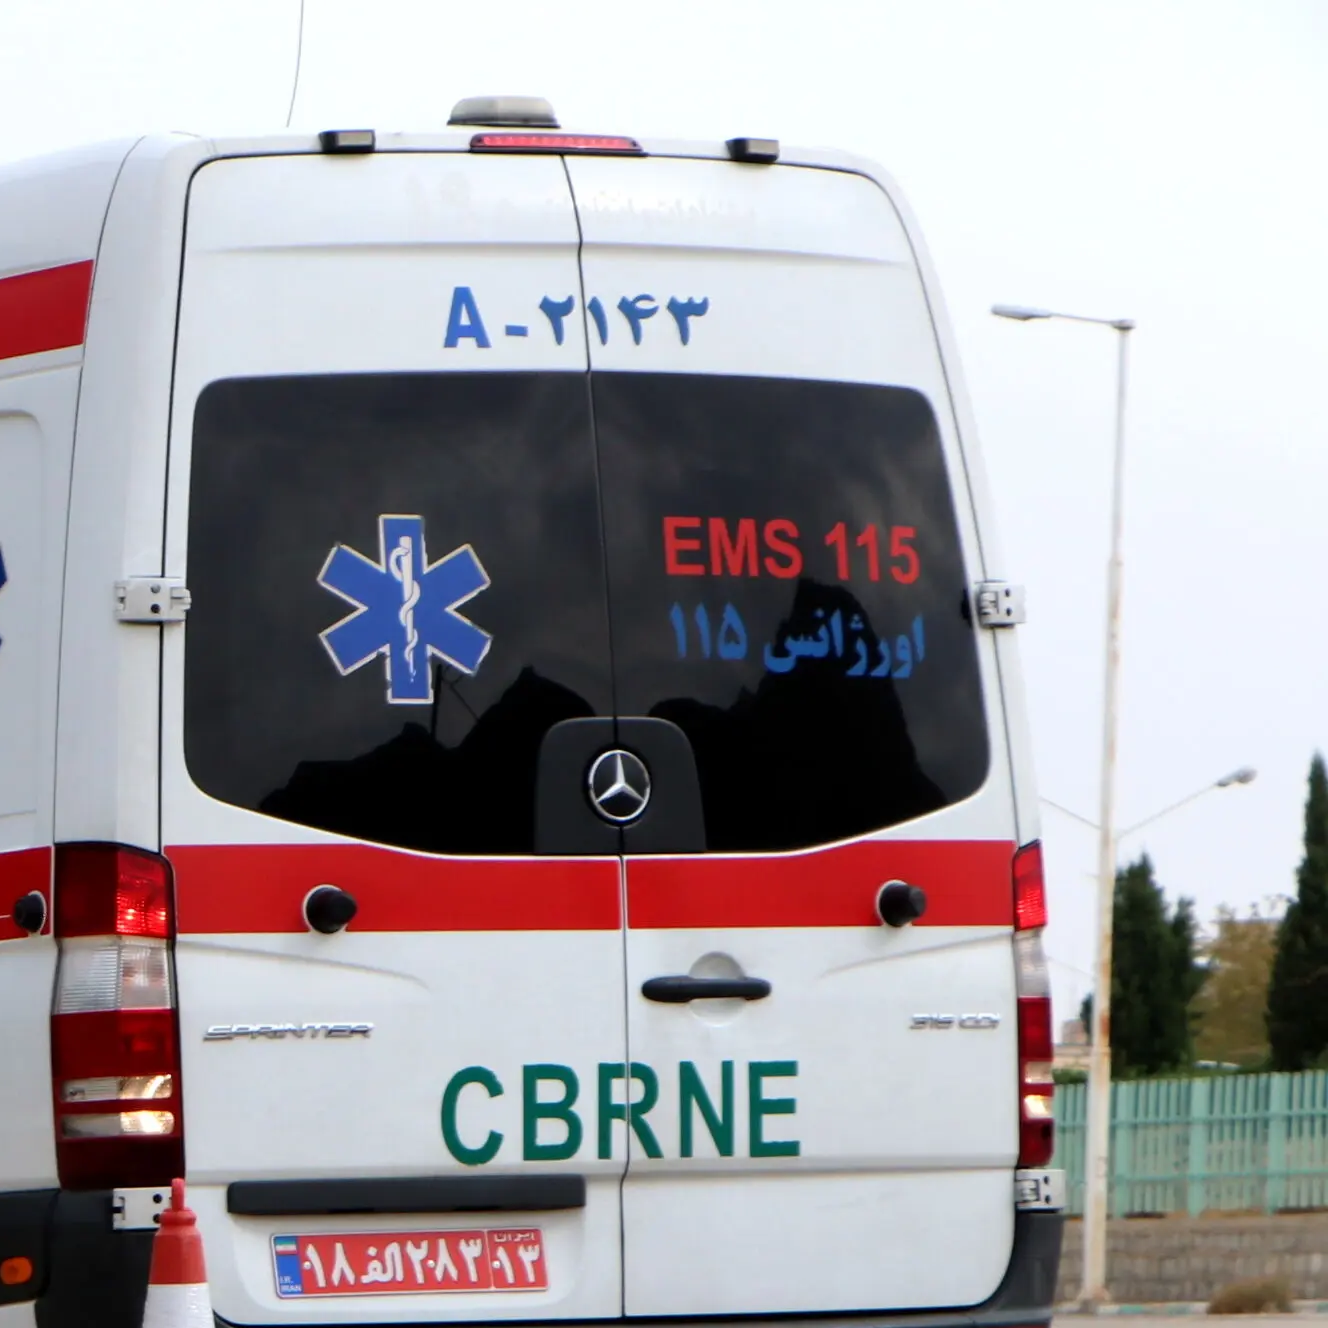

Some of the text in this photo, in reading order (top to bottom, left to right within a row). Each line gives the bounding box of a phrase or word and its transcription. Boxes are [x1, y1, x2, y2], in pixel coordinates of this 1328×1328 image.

[663, 516, 920, 584] EMS 115
[669, 601, 925, 679] اورژانس ۱۱۵
[202, 1021, 376, 1042] SPRINTER
[440, 1060, 801, 1167] CBRNE
[496, 1243, 540, 1284] ۱۳
